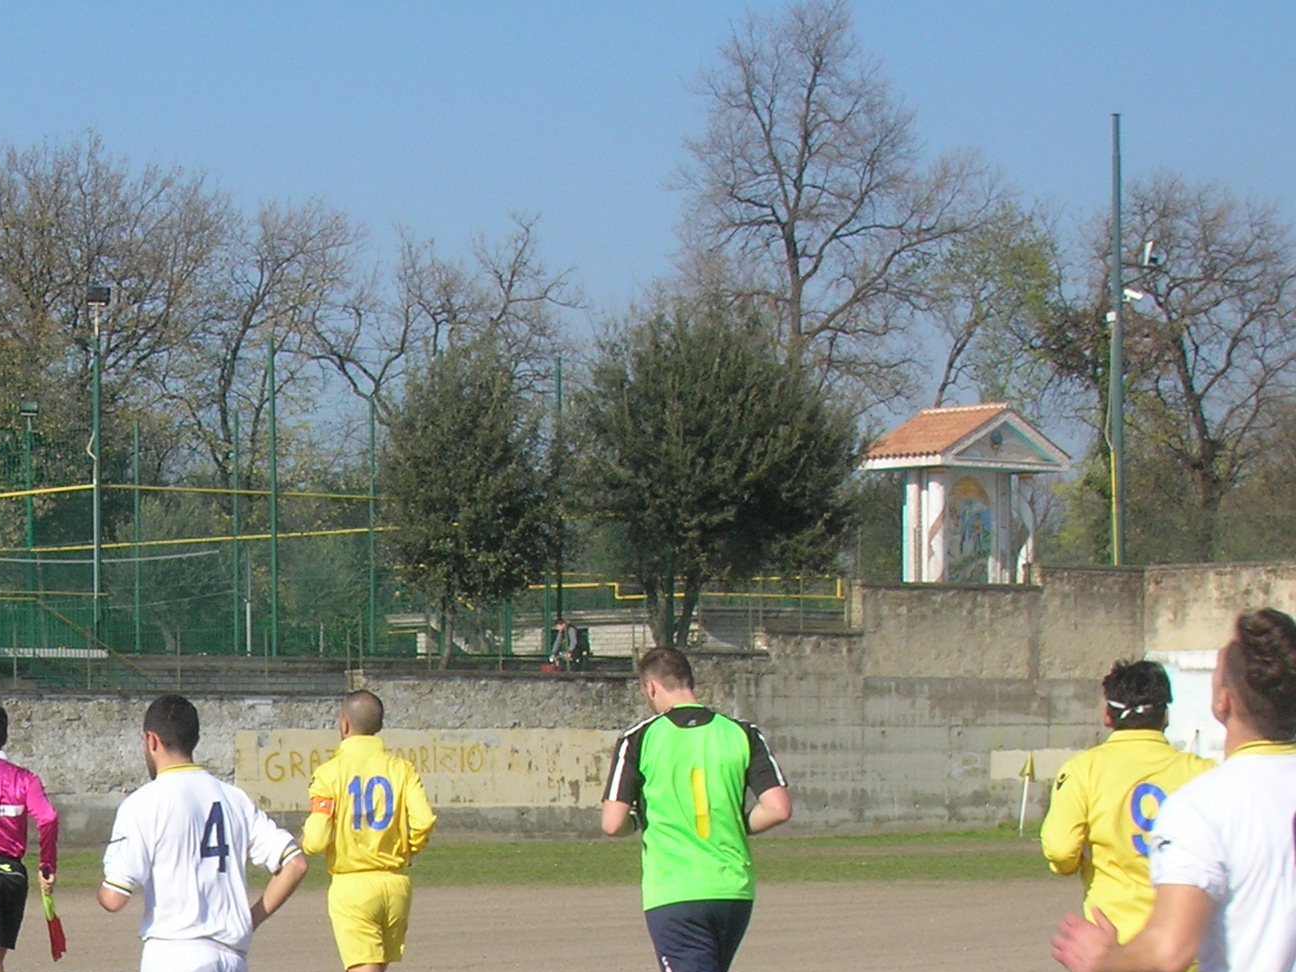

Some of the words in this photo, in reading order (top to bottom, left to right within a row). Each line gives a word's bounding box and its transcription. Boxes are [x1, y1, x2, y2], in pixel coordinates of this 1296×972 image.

[264, 748, 338, 782] GRAZ
[348, 775, 394, 831] 10
[1130, 782, 1167, 857] 9
[200, 801, 230, 873] 4
